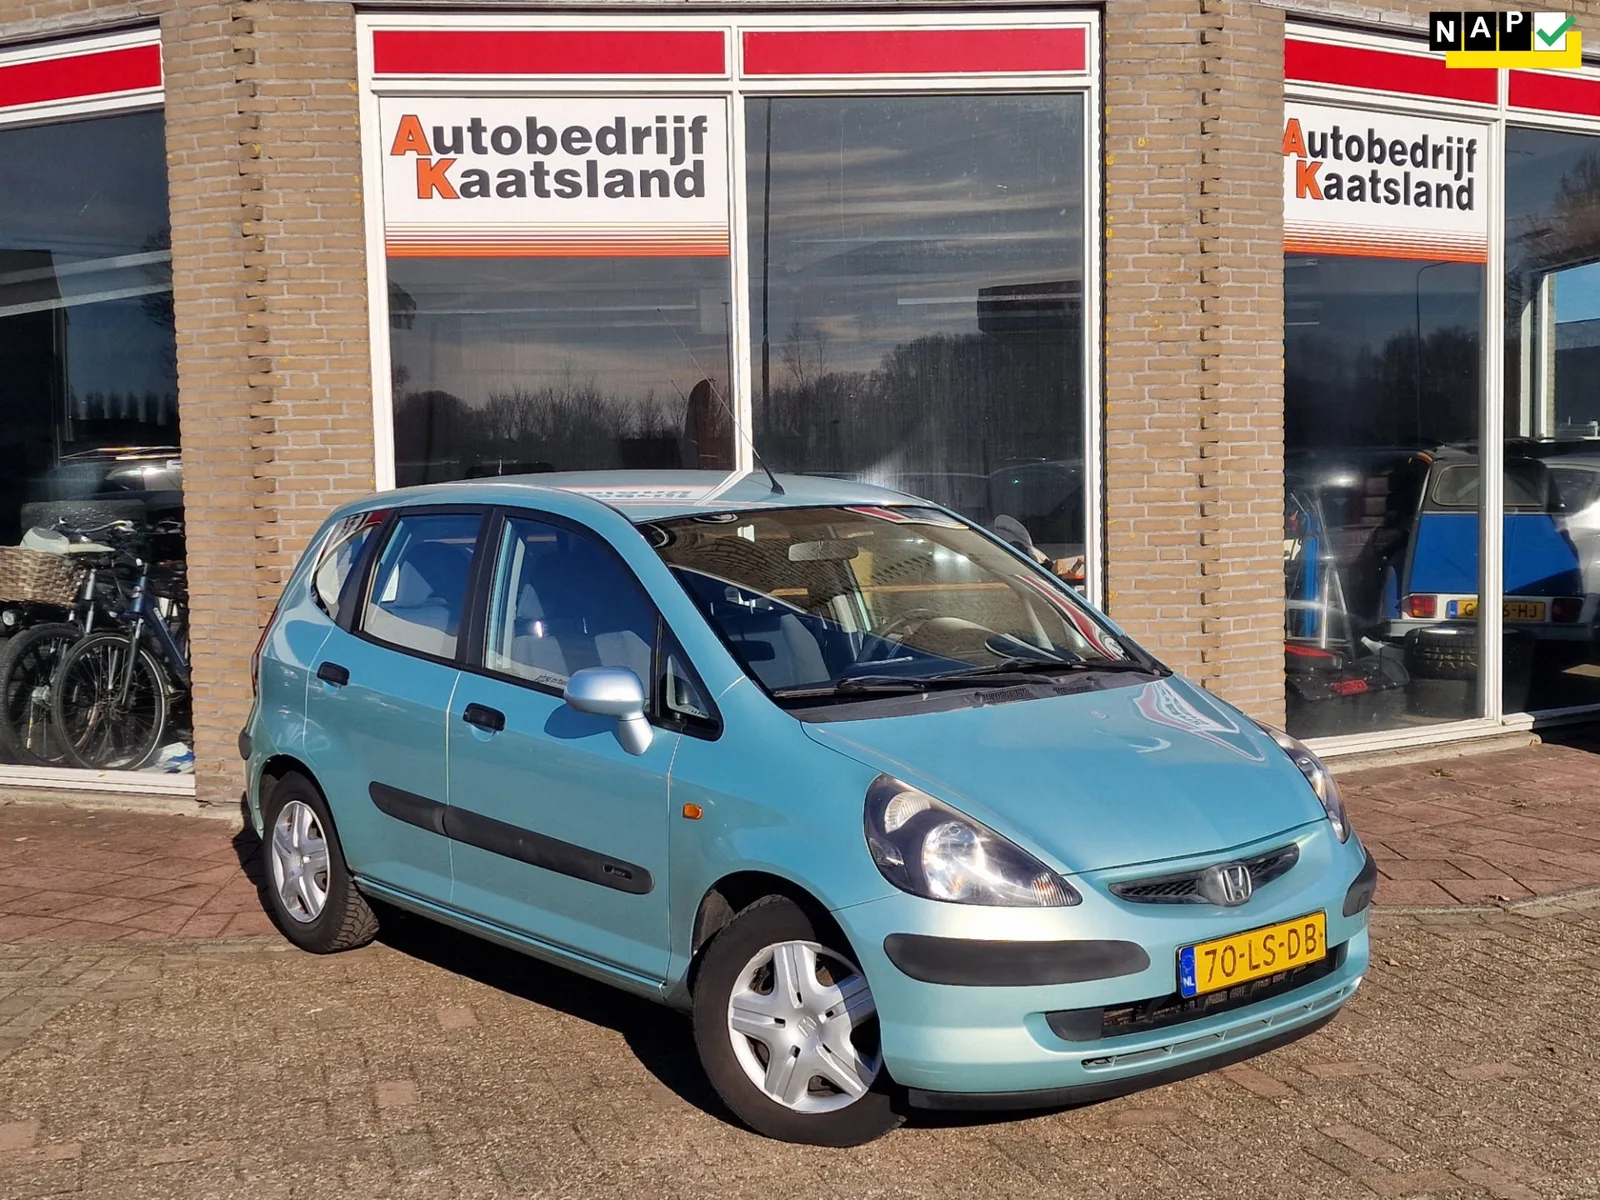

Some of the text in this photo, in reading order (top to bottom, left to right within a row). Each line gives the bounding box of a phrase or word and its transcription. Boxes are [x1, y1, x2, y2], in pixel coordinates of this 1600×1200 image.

[390, 114, 708, 166] Autobedrijf
[1283, 118, 1478, 182] Autobedrijf
[415, 157, 706, 200] Kaatsland
[1296, 159, 1475, 212] Kaatsland
[1204, 922, 1318, 984] 70-LS-DB
[1183, 976, 1196, 988] NL
